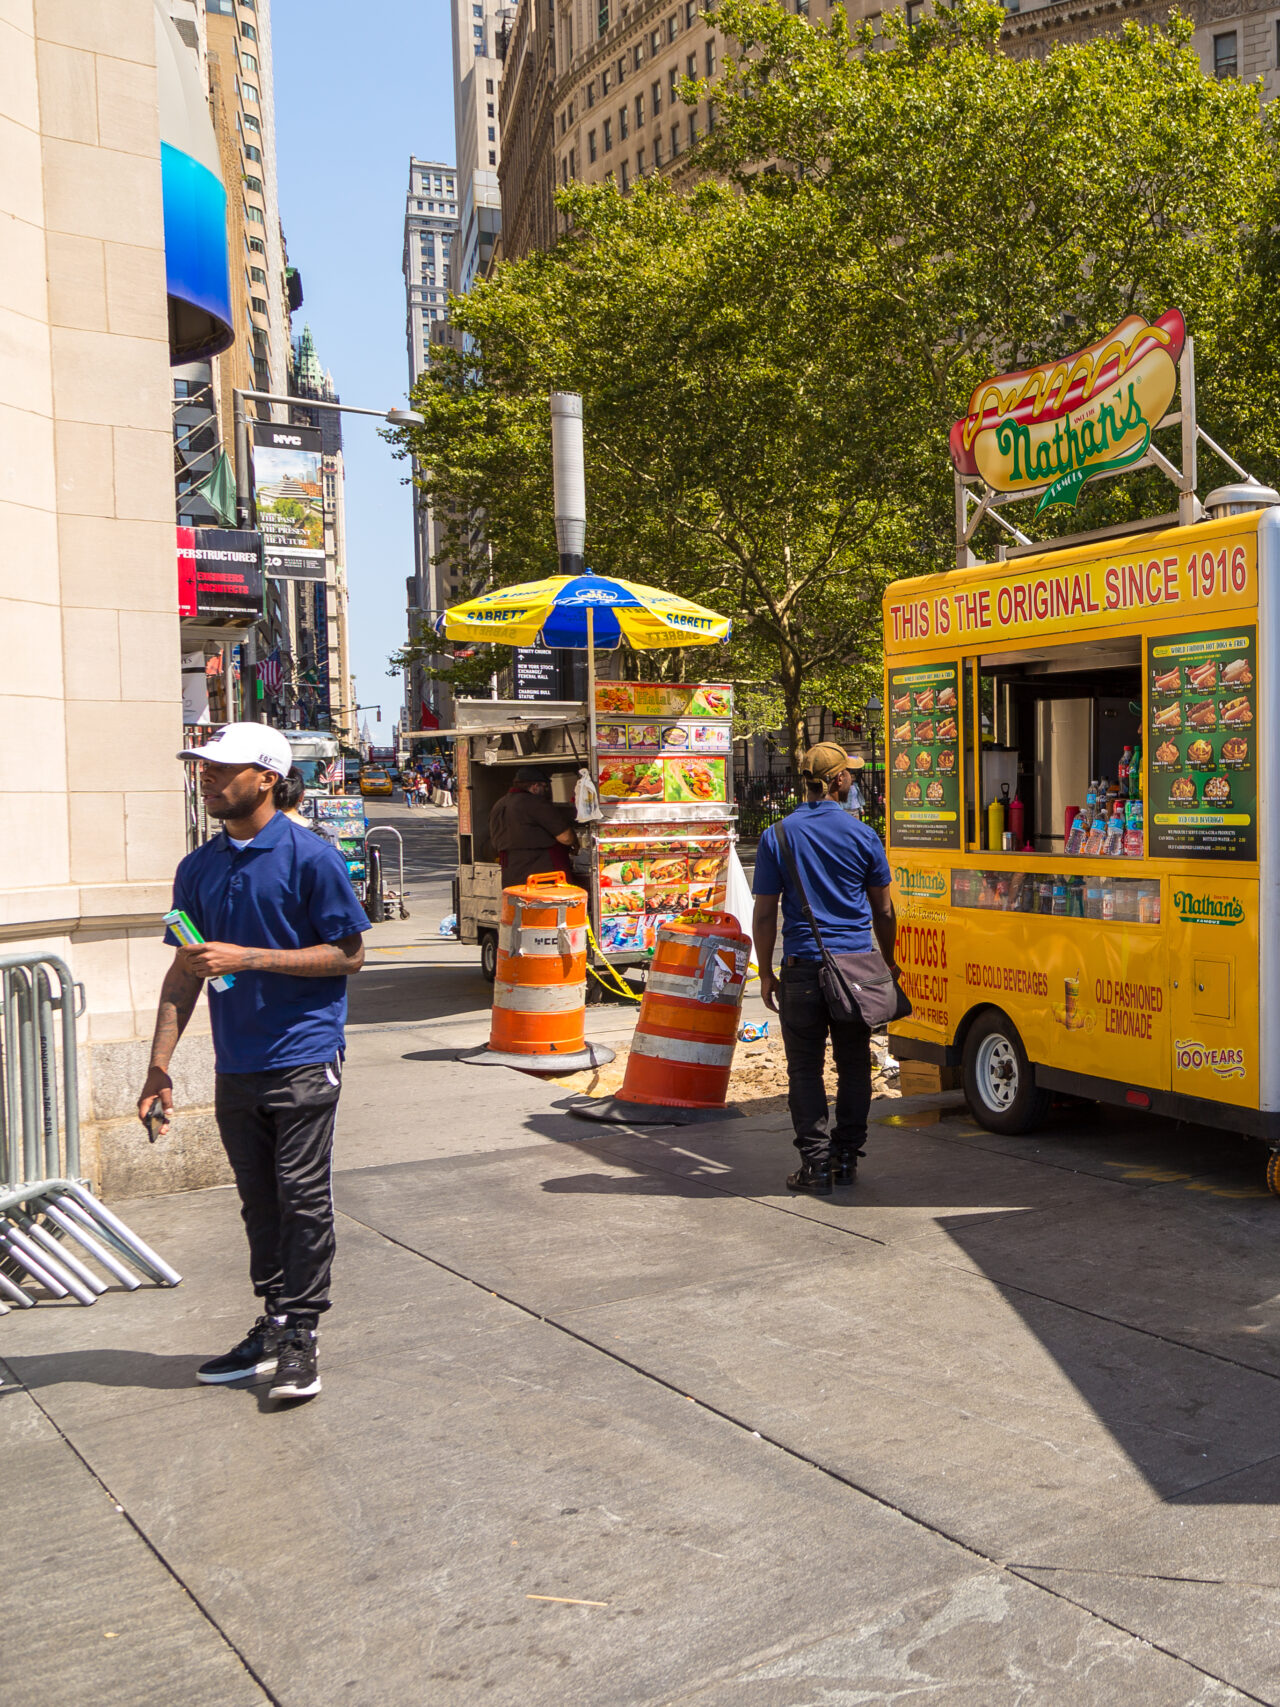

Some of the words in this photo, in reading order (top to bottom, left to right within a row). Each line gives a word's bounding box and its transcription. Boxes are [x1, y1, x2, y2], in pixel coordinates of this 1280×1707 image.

[273, 434, 301, 445] NYC
[997, 383, 1148, 482] Nathan's
[1051, 470, 1083, 497] FAMOUS
[177, 549, 257, 563] PERSTRUCTURES
[197, 572, 244, 583] ENGINEERS
[197, 585, 249, 594] ARCHITECTS
[891, 604, 929, 640] THIS
[934, 601, 951, 635] IS
[955, 591, 991, 631] THE
[999, 573, 1098, 624] ORIGINAL
[1106, 559, 1178, 611] SINCE
[1188, 548, 1246, 596] 1916
[467, 610, 527, 621] SABRETT
[667, 613, 712, 629] SABRETT
[637, 691, 671, 705] Halal
[894, 866, 946, 891] Nathan's
[1174, 891, 1243, 918] Nathan's
[896, 925, 912, 964] HOT
[914, 927, 938, 969] DOGS
[941, 929, 947, 969] &
[900, 971, 948, 1004] RINKLE-CUT
[965, 963, 981, 987] ICED
[982, 965, 1001, 989] COLD
[1003, 967, 1048, 997] BEVERAGES
[1095, 978, 1112, 1004] OLD
[1114, 981, 1163, 1013] FASHIONED
[928, 1008, 949, 1026] FRIES
[1105, 1008, 1152, 1040] LEMONADE
